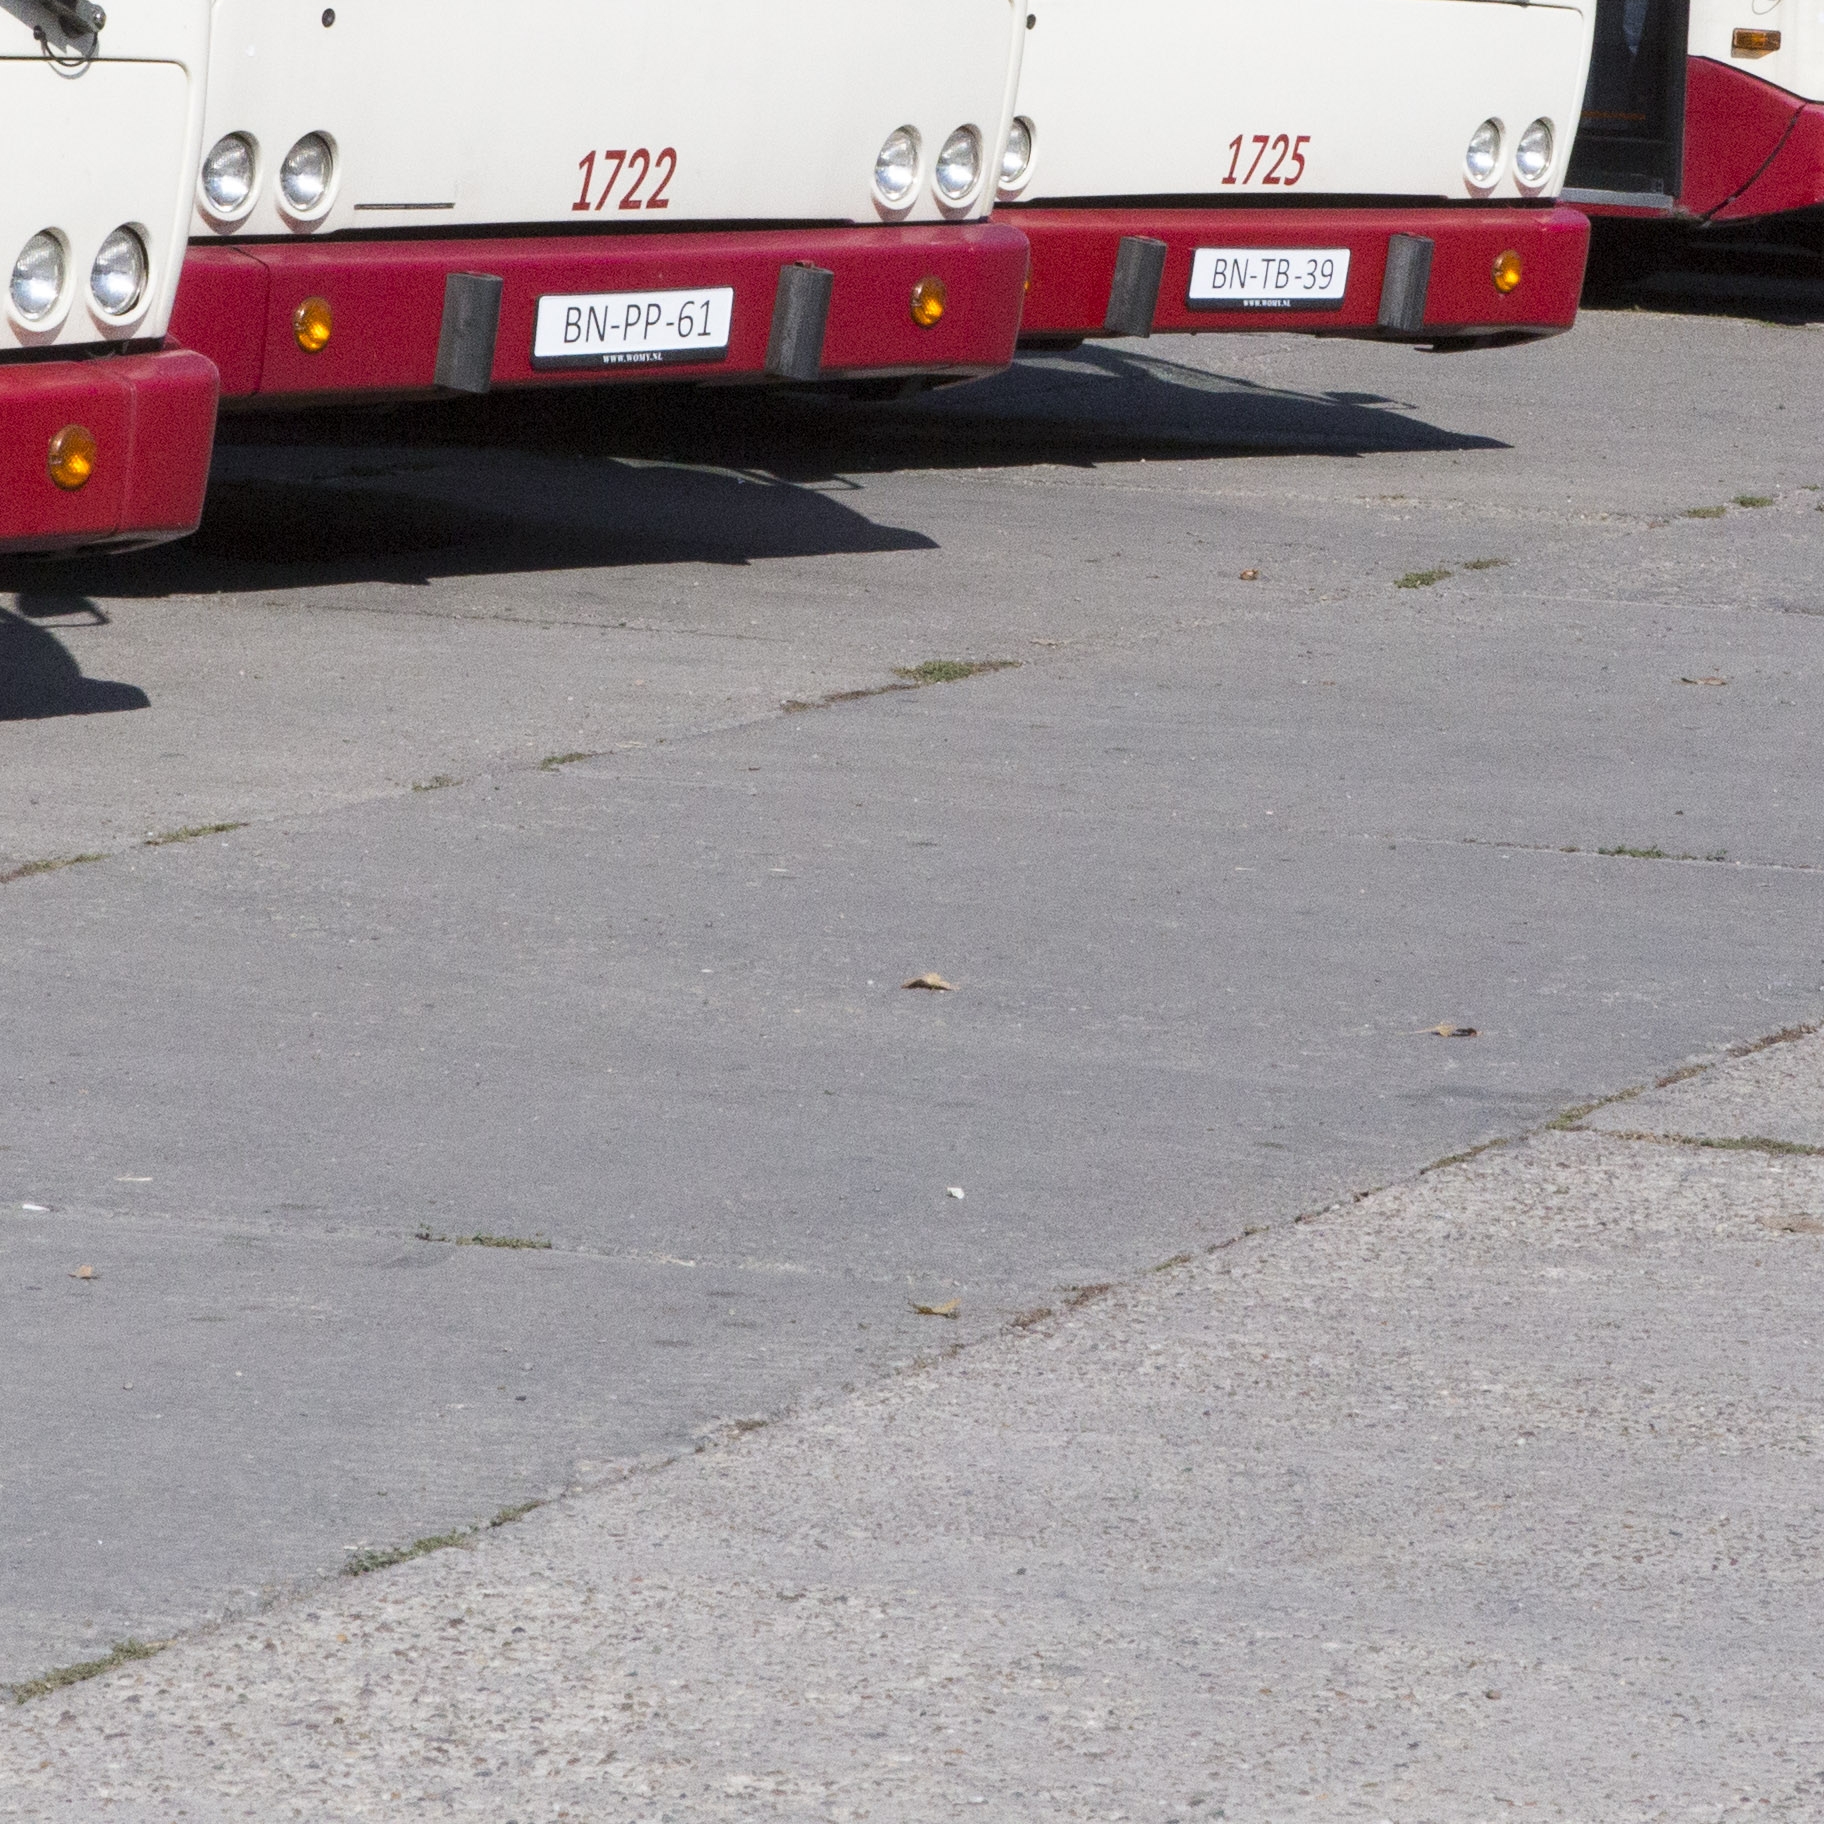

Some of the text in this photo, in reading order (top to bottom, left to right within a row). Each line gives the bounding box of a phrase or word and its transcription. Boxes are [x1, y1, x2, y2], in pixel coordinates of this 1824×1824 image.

[571, 146, 678, 211] 1722
[1221, 133, 1311, 186] 1725
[1211, 258, 1335, 290] BN-TB-39
[563, 299, 712, 344] BN-PP-61
